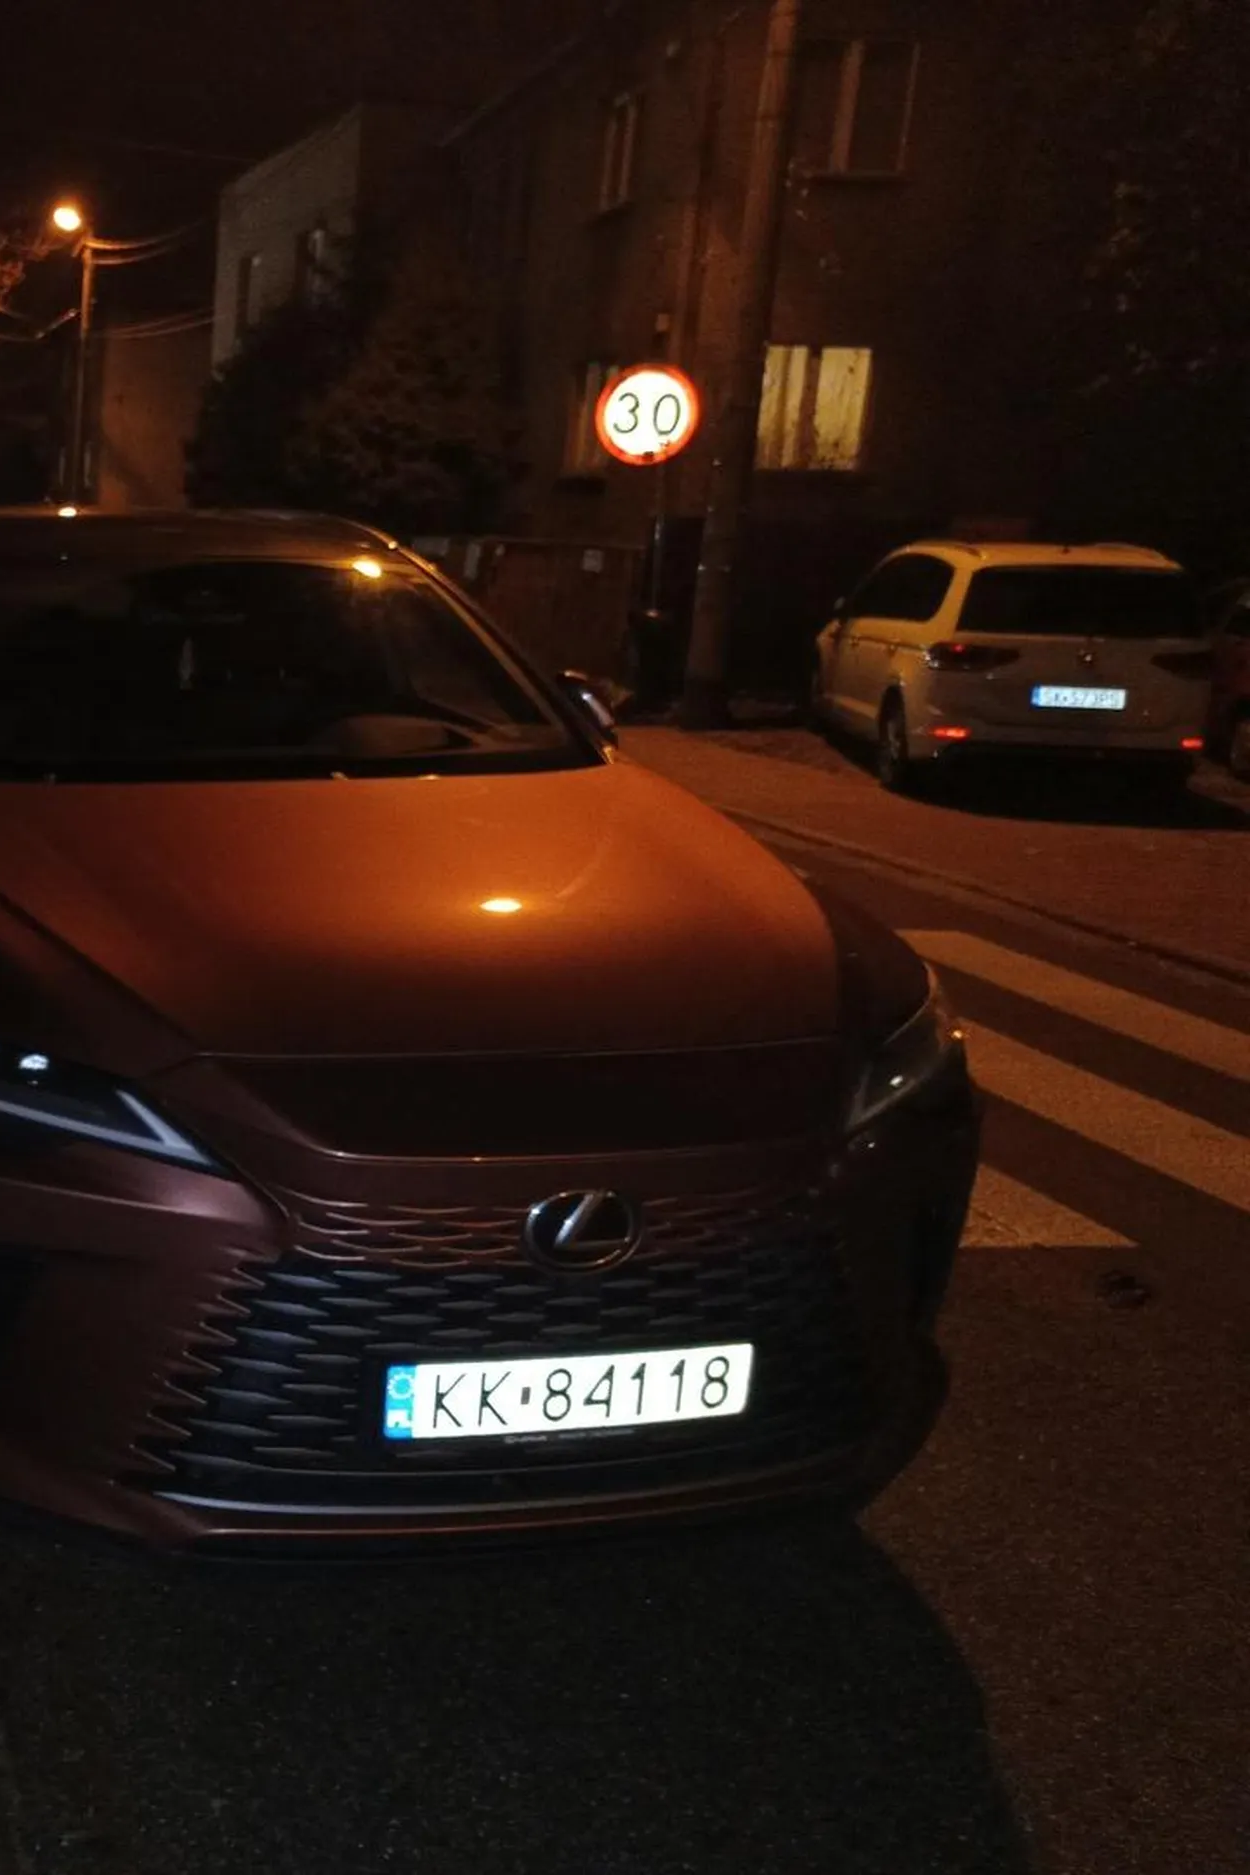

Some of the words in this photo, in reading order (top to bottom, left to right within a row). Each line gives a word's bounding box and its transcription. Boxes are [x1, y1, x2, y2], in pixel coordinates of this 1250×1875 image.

[613, 392, 681, 435] 30
[433, 1371, 512, 1429] KK
[542, 1356, 730, 1422] 84118
